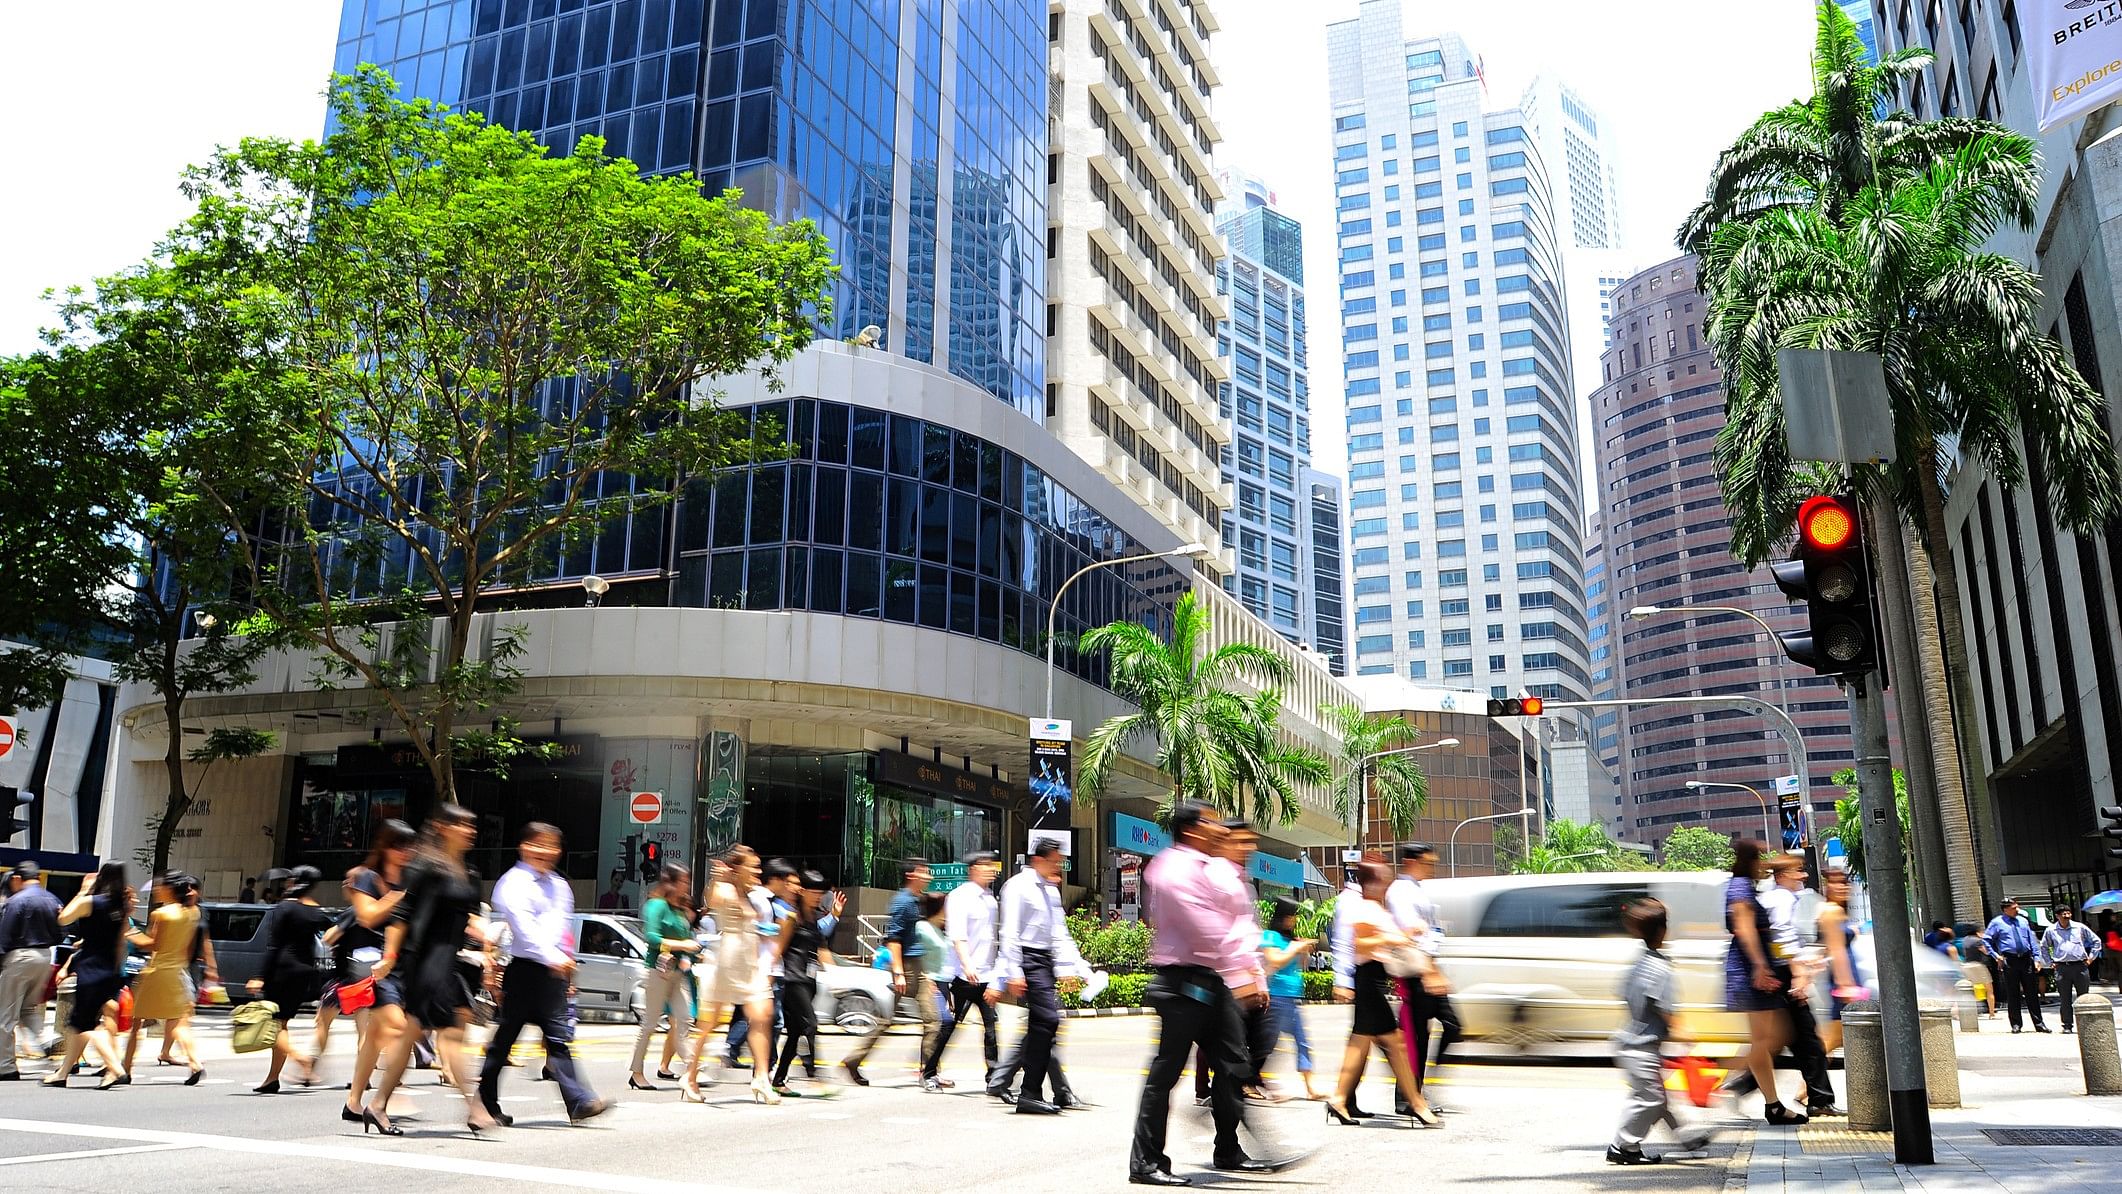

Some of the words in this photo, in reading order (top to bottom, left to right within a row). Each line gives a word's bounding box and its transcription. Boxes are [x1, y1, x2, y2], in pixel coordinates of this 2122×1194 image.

[2053, 0, 2122, 46] BREIT
[2052, 59, 2122, 102] Explore
[925, 769, 941, 782] THAI
[1131, 824, 1144, 844] RHB
[1148, 835, 1160, 849] Bank
[929, 867, 947, 877] oon
[950, 866, 964, 877] Tat
